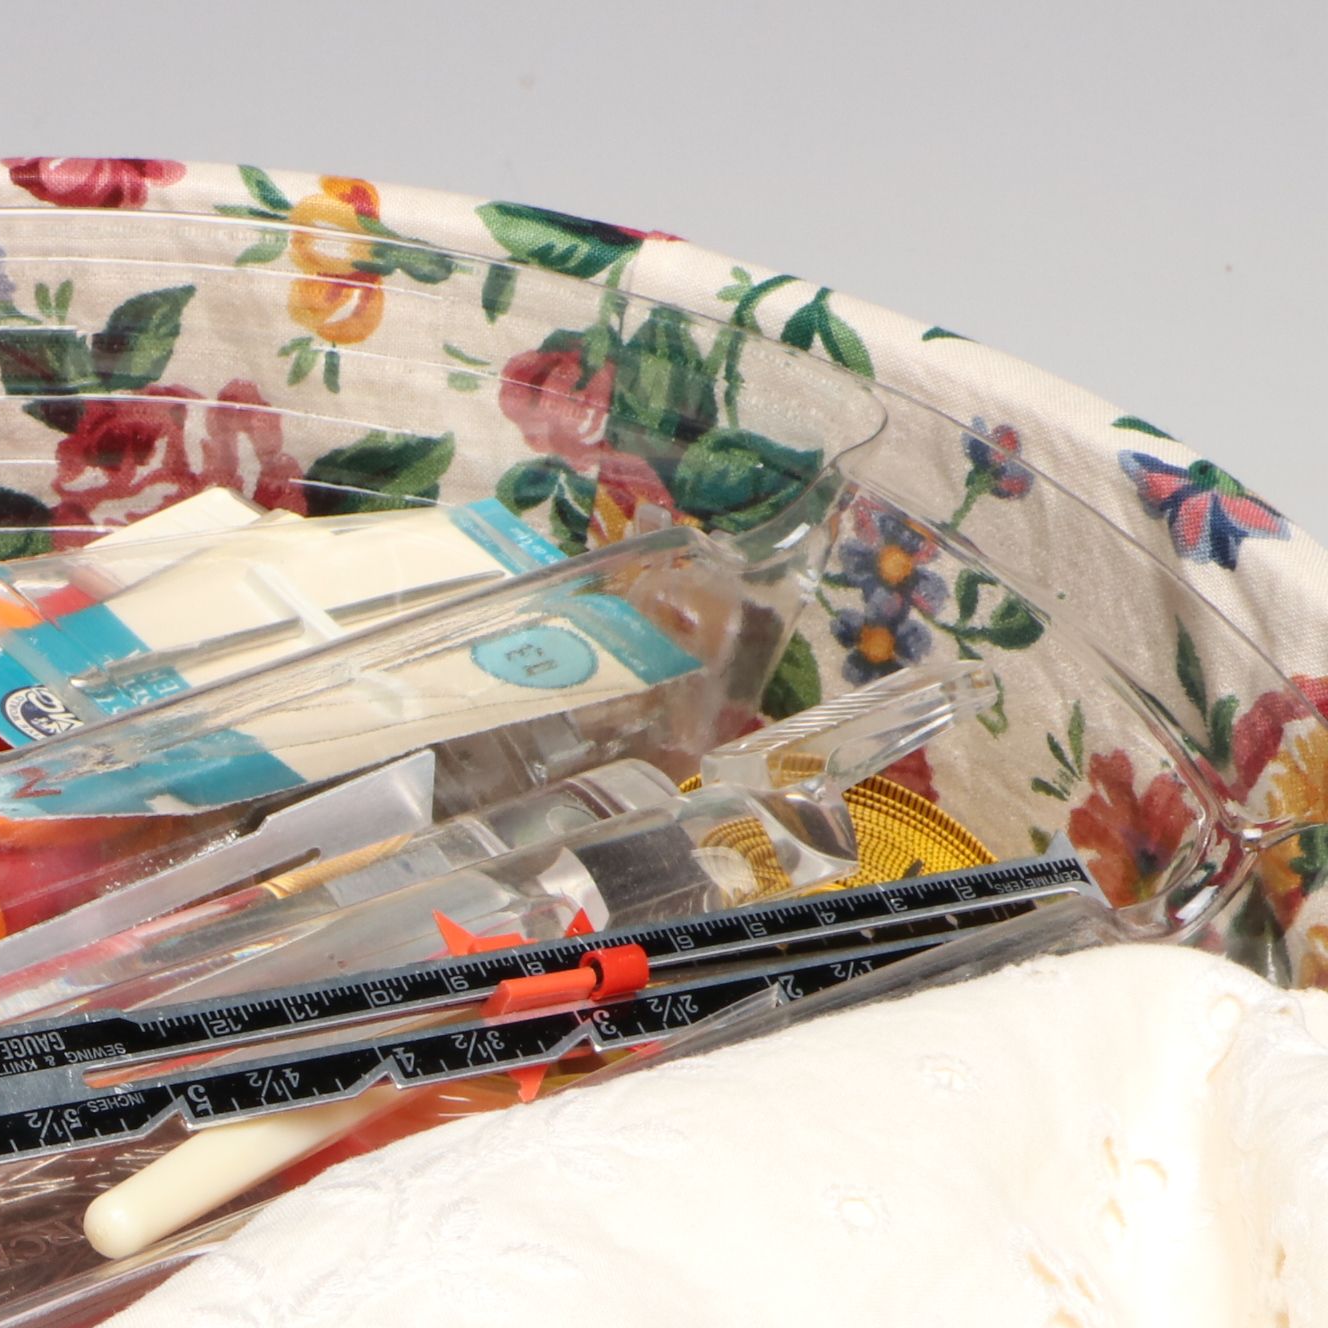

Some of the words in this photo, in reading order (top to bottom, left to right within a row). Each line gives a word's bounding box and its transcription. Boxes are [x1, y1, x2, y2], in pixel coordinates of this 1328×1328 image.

[991, 869, 1082, 894] CENTIMETERS
[957, 885, 977, 900] 2
[890, 897, 908, 912] 3
[821, 911, 837, 924] 4
[750, 922, 768, 937] 5
[676, 934, 695, 950] 6
[526, 961, 546, 976] 8
[450, 975, 470, 991] 9
[778, 974, 805, 1000] 2
[371, 989, 405, 1006] 10
[292, 1002, 320, 1020] 11
[209, 1019, 243, 1036] 12
[592, 1009, 618, 1035] 3
[45, 1056, 56, 1067] &
[63, 1042, 127, 1064] SEWING
[392, 1046, 416, 1074] 4
[86, 1092, 146, 1114] INCHES
[186, 1084, 214, 1115] 5
